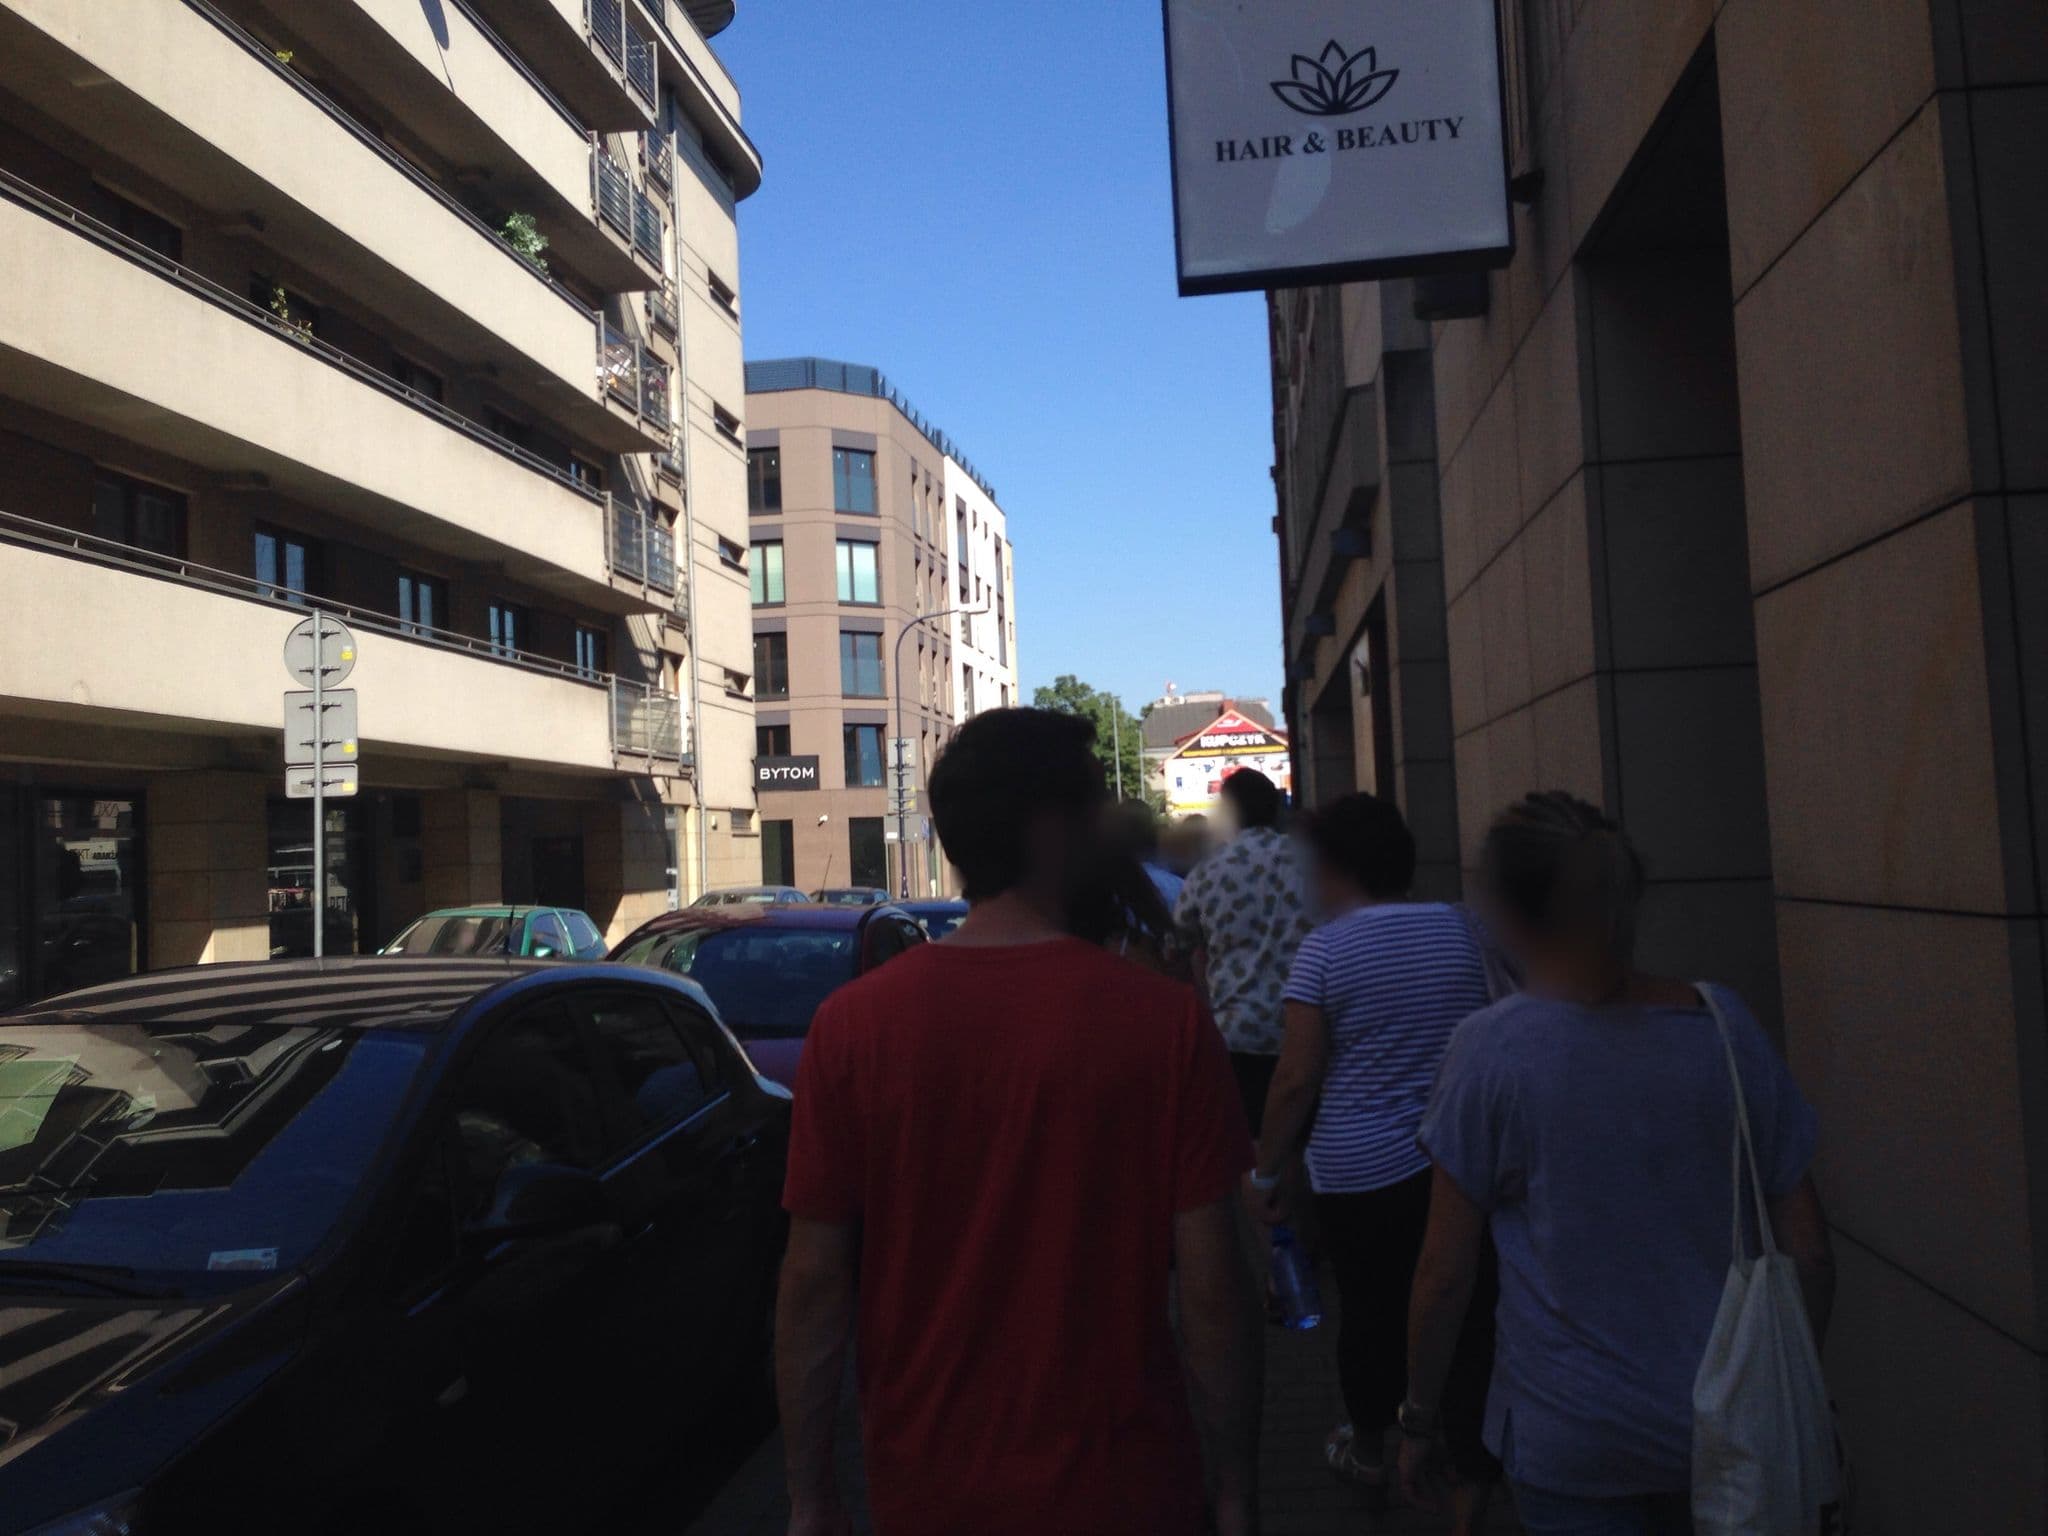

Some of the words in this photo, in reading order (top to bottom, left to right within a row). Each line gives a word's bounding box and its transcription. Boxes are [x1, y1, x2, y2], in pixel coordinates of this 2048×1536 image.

[1216, 135, 1294, 162] HAIR
[1302, 131, 1326, 155] &
[1336, 116, 1464, 151] BEAUTY
[760, 767, 815, 780] BYTOM
